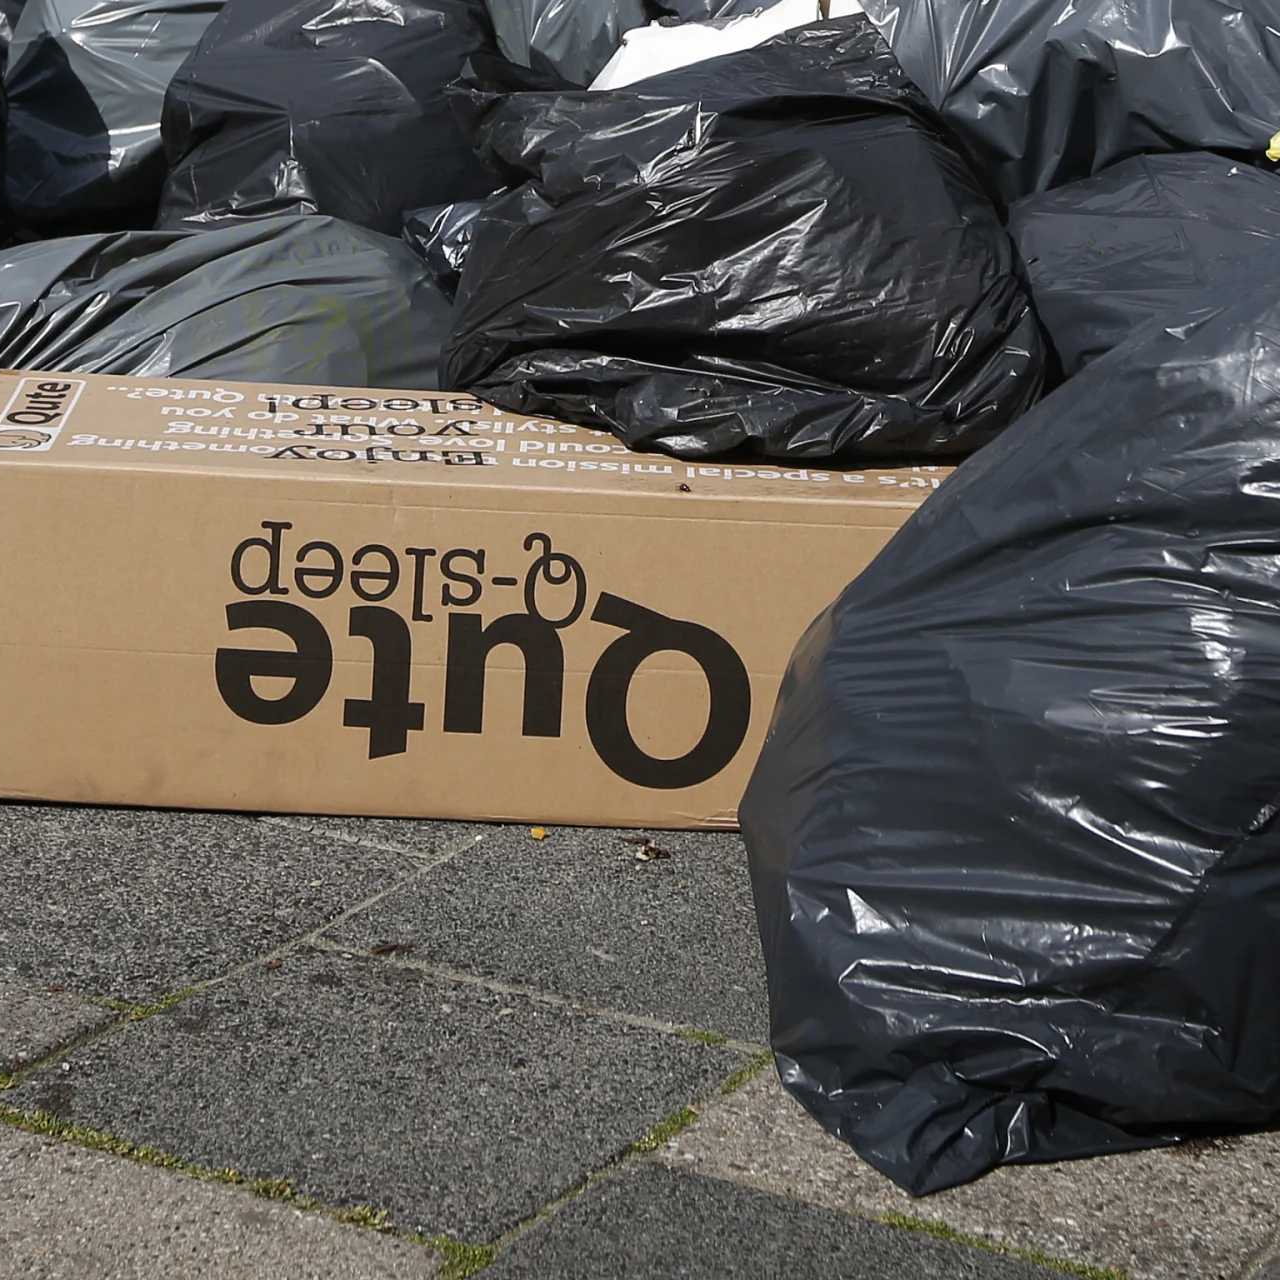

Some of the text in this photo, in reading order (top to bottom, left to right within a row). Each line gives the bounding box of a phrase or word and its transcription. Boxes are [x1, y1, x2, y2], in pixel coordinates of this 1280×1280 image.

[7, 382, 71, 424] Qute
[160, 405, 237, 418] you
[267, 394, 483, 414] sleep!
[248, 410, 299, 424] do
[312, 413, 419, 429] What
[294, 420, 477, 436] your
[67, 433, 290, 456] omething
[164, 421, 631, 455] could love. Something
[263, 445, 496, 466] Enjoy
[513, 457, 672, 476] mission
[687, 467, 829, 483] special
[843, 473, 866, 484] a
[230, 521, 587, 630] Q-sleep
[214, 591, 752, 791] Qute
